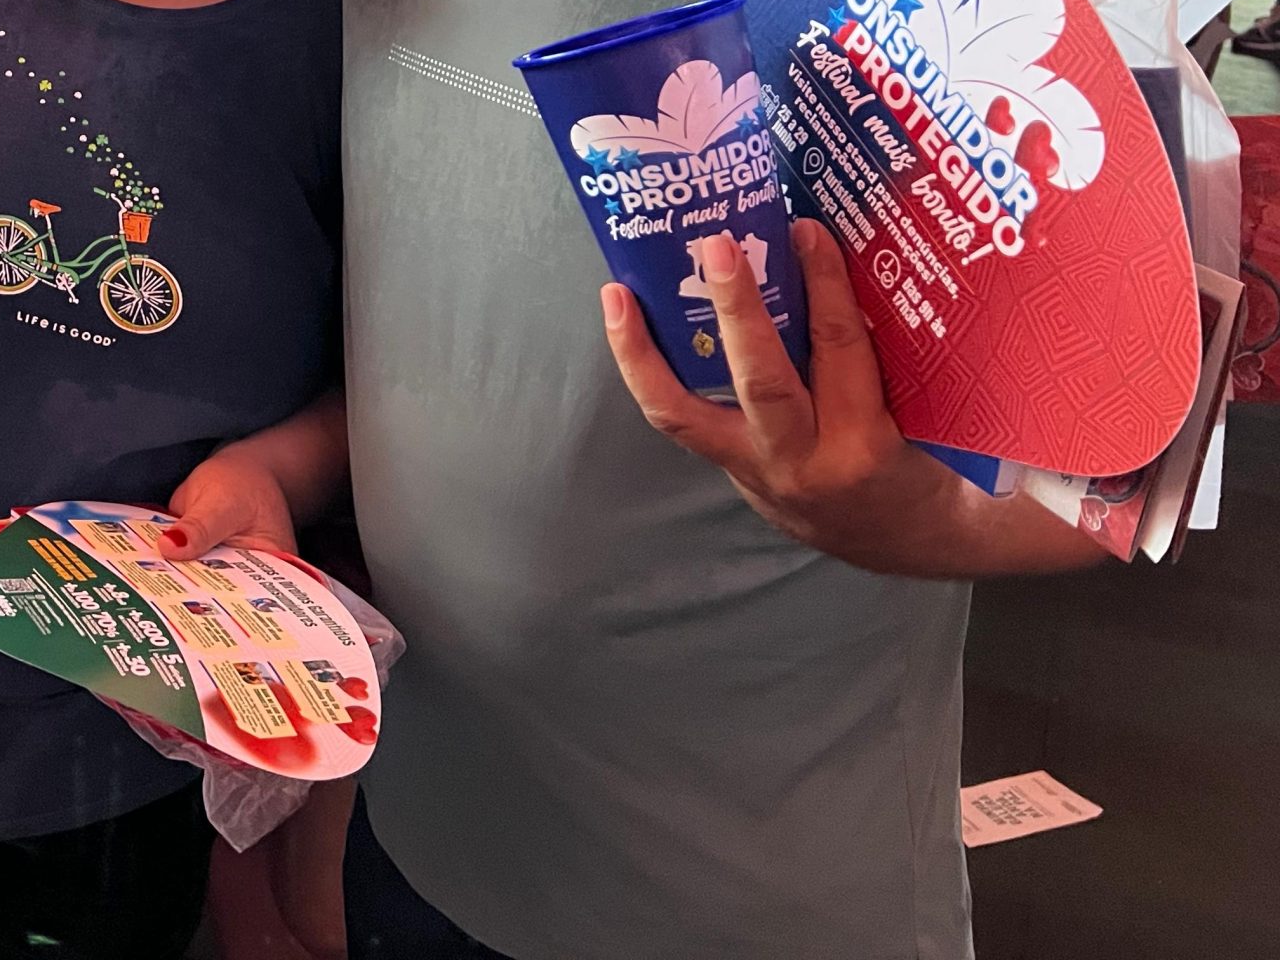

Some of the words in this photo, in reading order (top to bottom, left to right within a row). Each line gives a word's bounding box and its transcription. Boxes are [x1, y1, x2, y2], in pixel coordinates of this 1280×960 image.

[776, 104, 791, 120] 25
[787, 118, 798, 130] a
[795, 129, 810, 147] 29
[796, 19, 876, 117] Festival
[863, 114, 918, 173] mais
[910, 172, 995, 266] bonito!
[842, 22, 1025, 257] PROTEGIDO
[580, 128, 772, 197] CONSUMIDOR
[621, 149, 778, 214] PROTEGIDO
[788, 61, 818, 105] Visite
[815, 101, 849, 145] nosso
[845, 140, 878, 184] stand
[872, 181, 903, 220] para
[899, 214, 961, 300] denúncias,
[793, 94, 859, 184] reclamações
[855, 180, 867, 191] e
[862, 184, 937, 286] informações!
[606, 209, 674, 241] Festival
[682, 199, 731, 227] mais
[812, 179, 838, 218] Praça
[834, 210, 868, 255] Central
[822, 164, 877, 241] Turistódromo
[53, 322, 66, 335] IS
[891, 290, 922, 330] 17h30
[901, 276, 921, 301] Das
[918, 298, 934, 318] 9h
[930, 314, 948, 339] às
[307, 603, 356, 647] Garantidos
